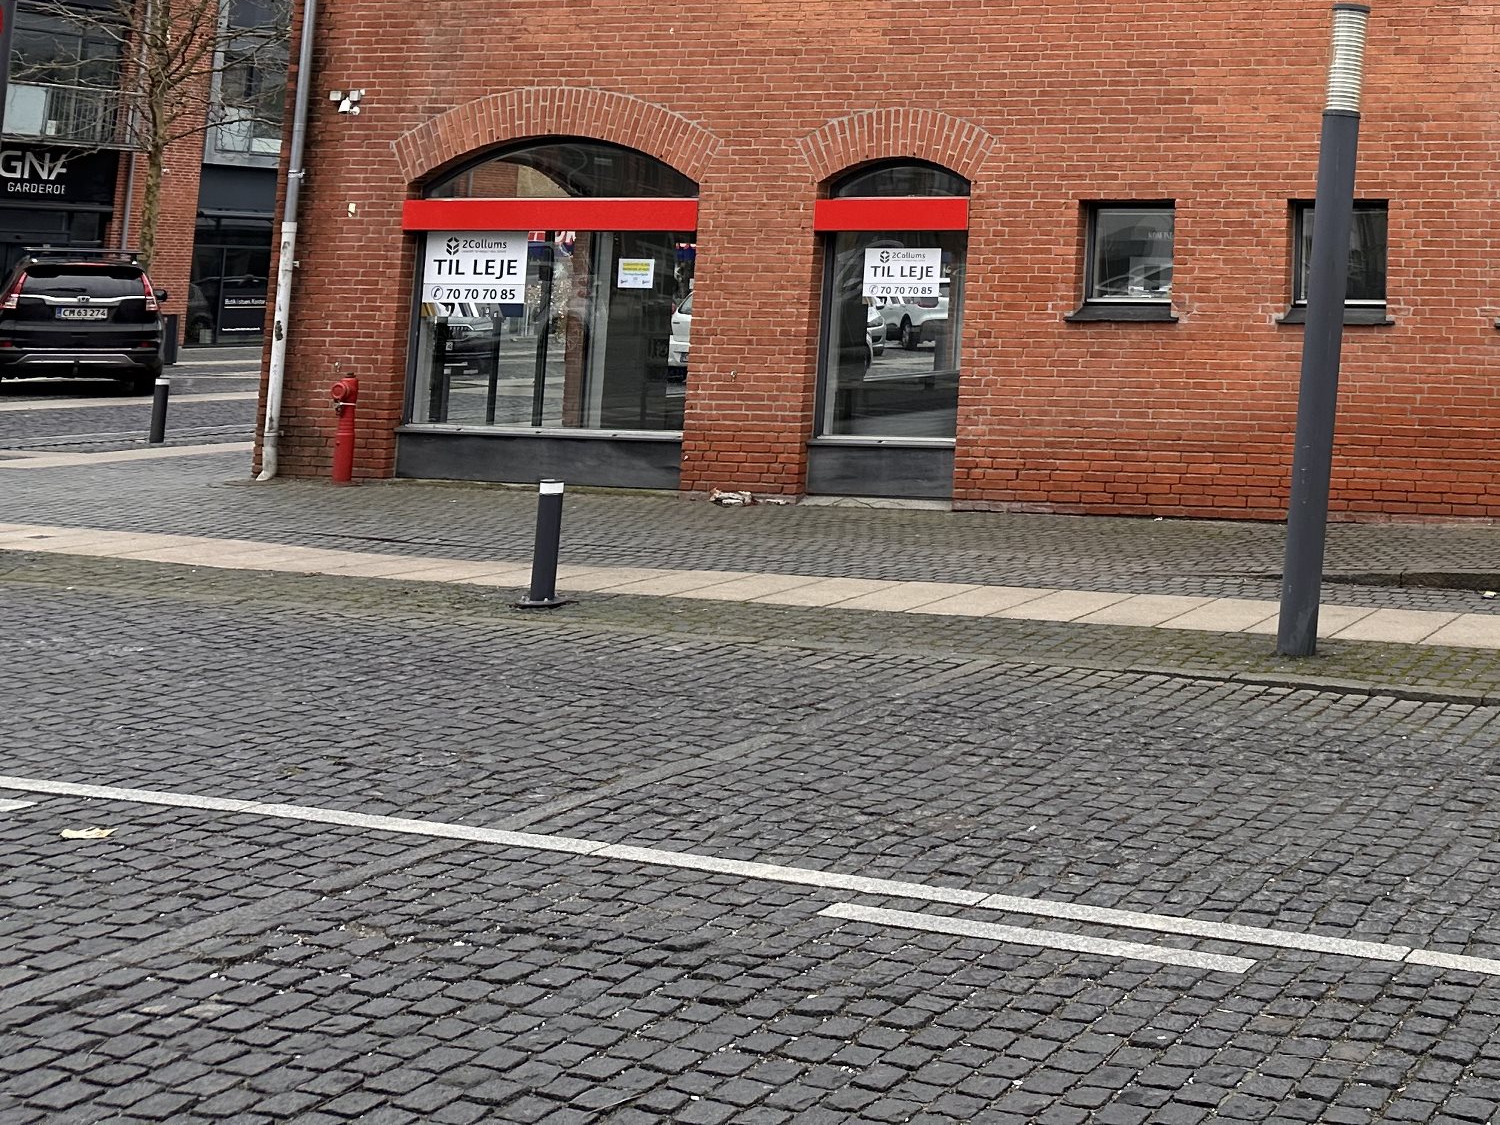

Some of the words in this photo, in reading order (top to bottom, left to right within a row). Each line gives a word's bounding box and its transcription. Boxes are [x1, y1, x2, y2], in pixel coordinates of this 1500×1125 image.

[462, 239, 507, 249] 2Collums
[433, 259, 465, 275] TIL
[473, 259, 518, 279] LEJE
[870, 266, 895, 277] TIL
[900, 266, 934, 280] LEJE
[446, 289, 461, 299] 70
[464, 289, 479, 299] 70
[482, 289, 497, 299] 70
[500, 289, 515, 299] 85
